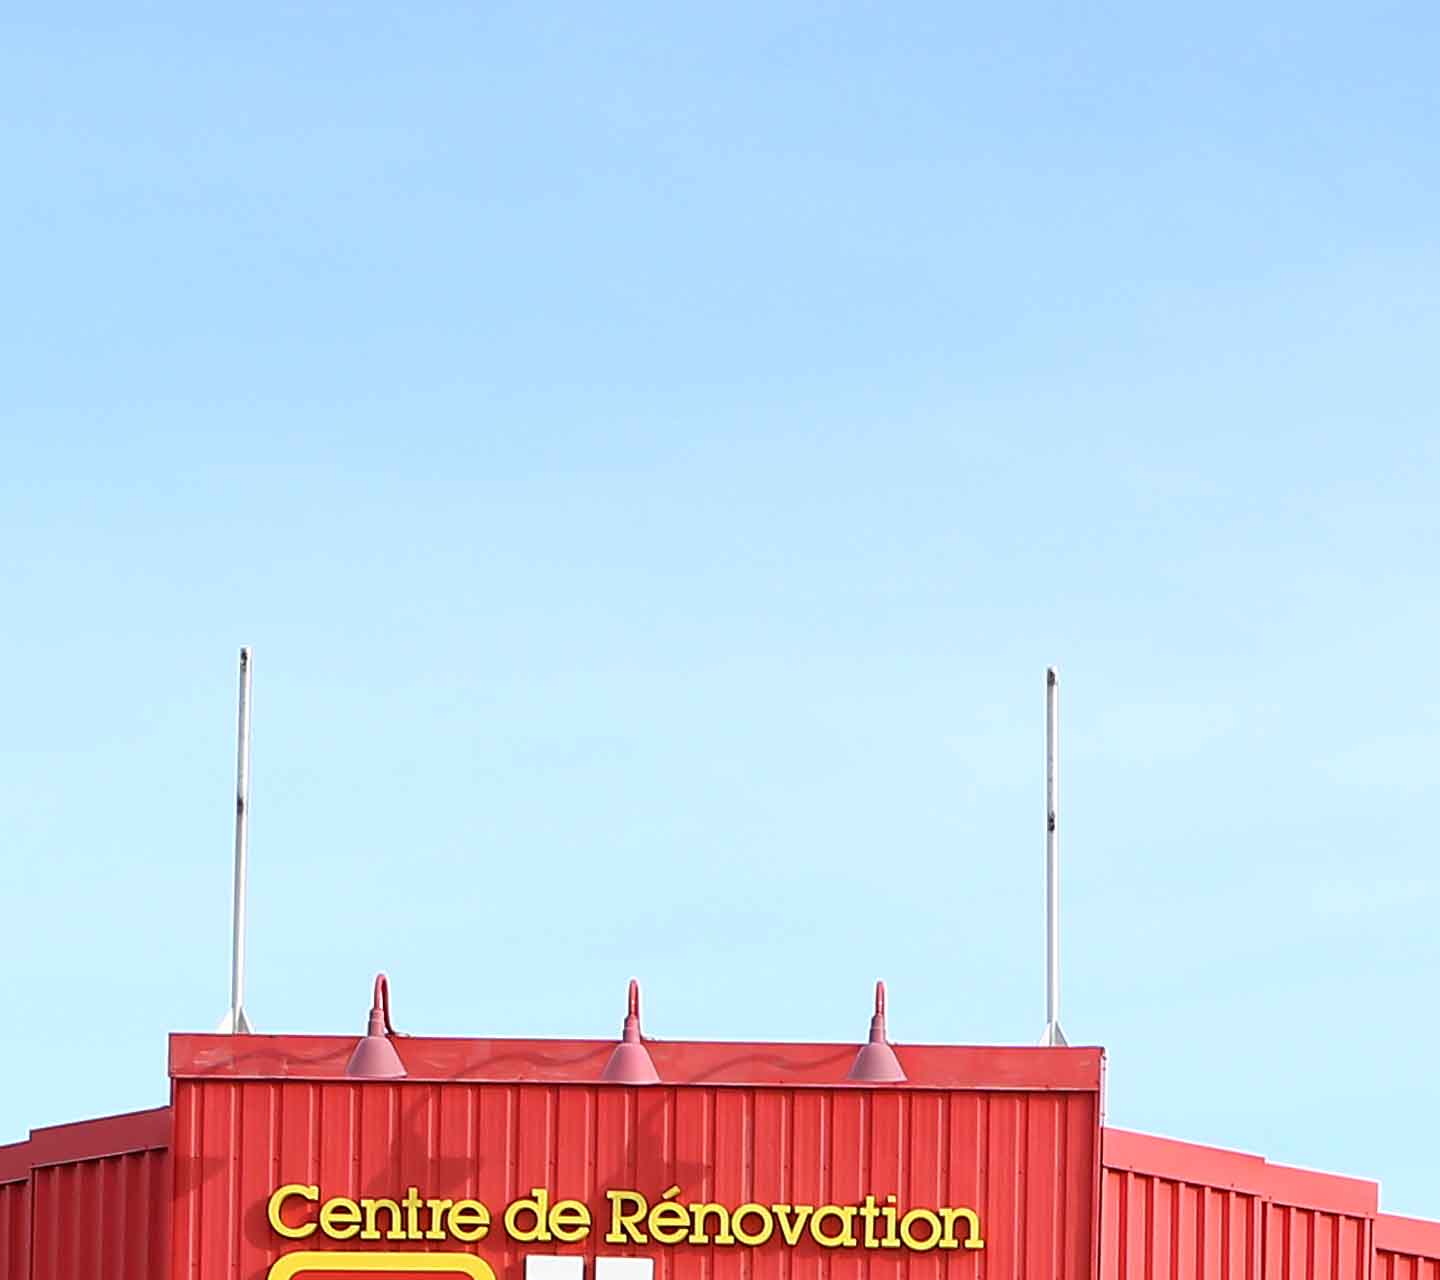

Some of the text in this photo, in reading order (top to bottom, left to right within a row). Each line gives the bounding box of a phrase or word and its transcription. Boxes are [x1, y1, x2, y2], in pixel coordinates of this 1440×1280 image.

[267, 1184, 984, 1250] Centre de Rénovation
